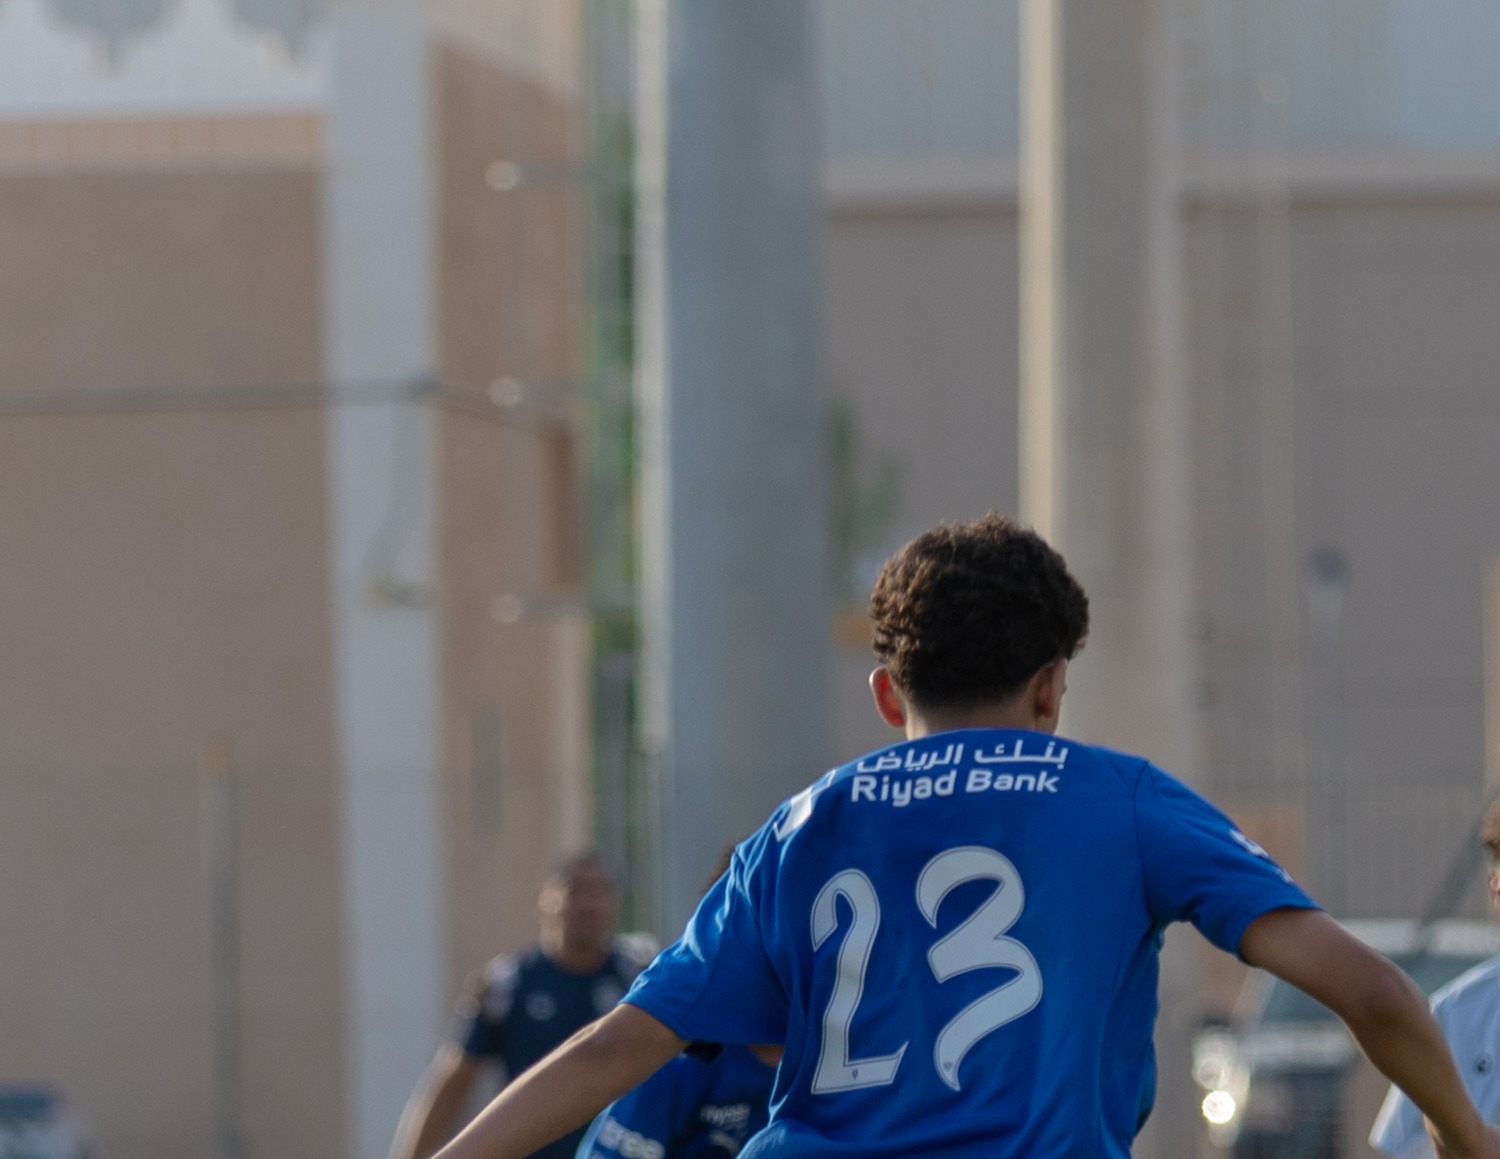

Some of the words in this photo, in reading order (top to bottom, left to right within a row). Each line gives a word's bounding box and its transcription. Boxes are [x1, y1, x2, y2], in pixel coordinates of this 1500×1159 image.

[856, 742, 965, 773] الرياض
[974, 739, 1069, 770] بنك
[851, 769, 957, 807] Riyad
[965, 768, 1060, 793] Bank
[810, 845, 1044, 1095] 23
